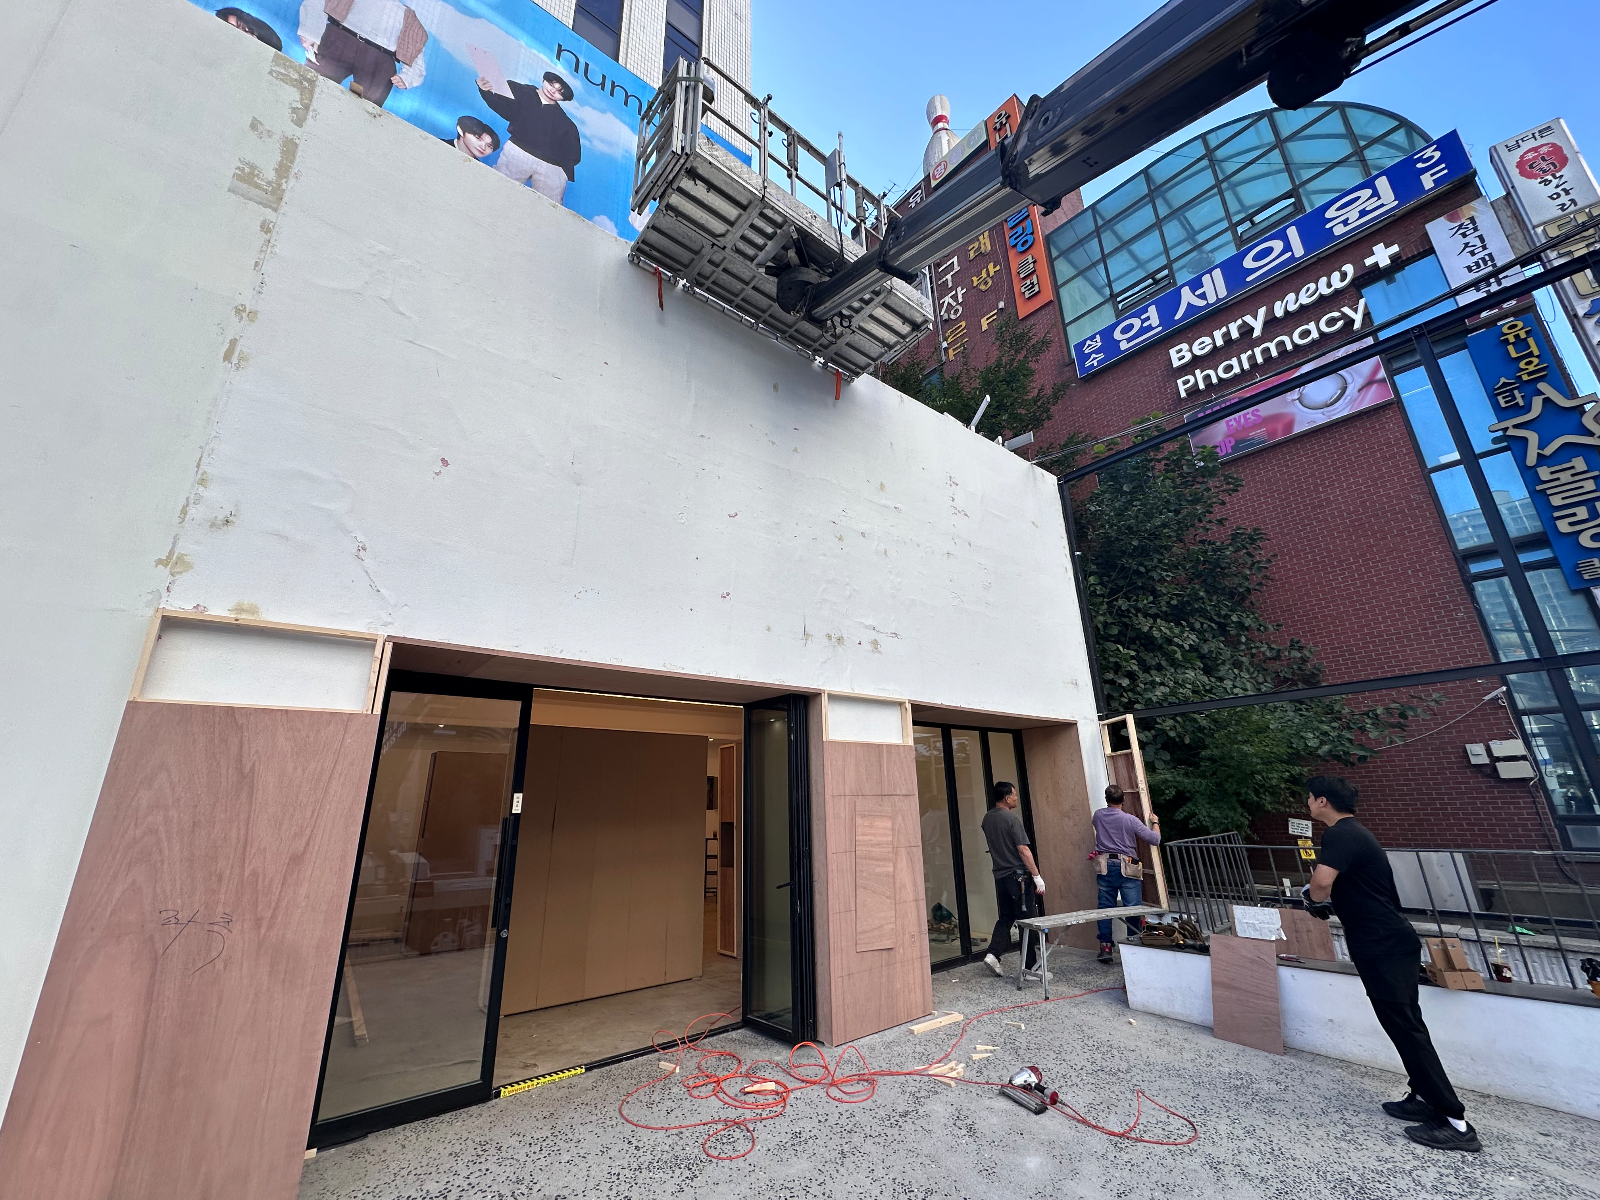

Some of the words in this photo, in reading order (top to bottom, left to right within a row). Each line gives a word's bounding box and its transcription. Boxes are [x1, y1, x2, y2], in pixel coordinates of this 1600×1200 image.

[1413, 145, 1448, 190] 3F
[1016, 254, 1040, 299] 클럽
[1113, 176, 1398, 351] 연세의원
[1168, 305, 1267, 369] Berry
[1273, 263, 1355, 319] new
[1083, 334, 1105, 367] 성수
[1176, 297, 1366, 399] Pharmacy
[1500, 320, 1549, 381] 유니온
[1493, 376, 1525, 408] 스타
[1225, 408, 1263, 435] EYES
